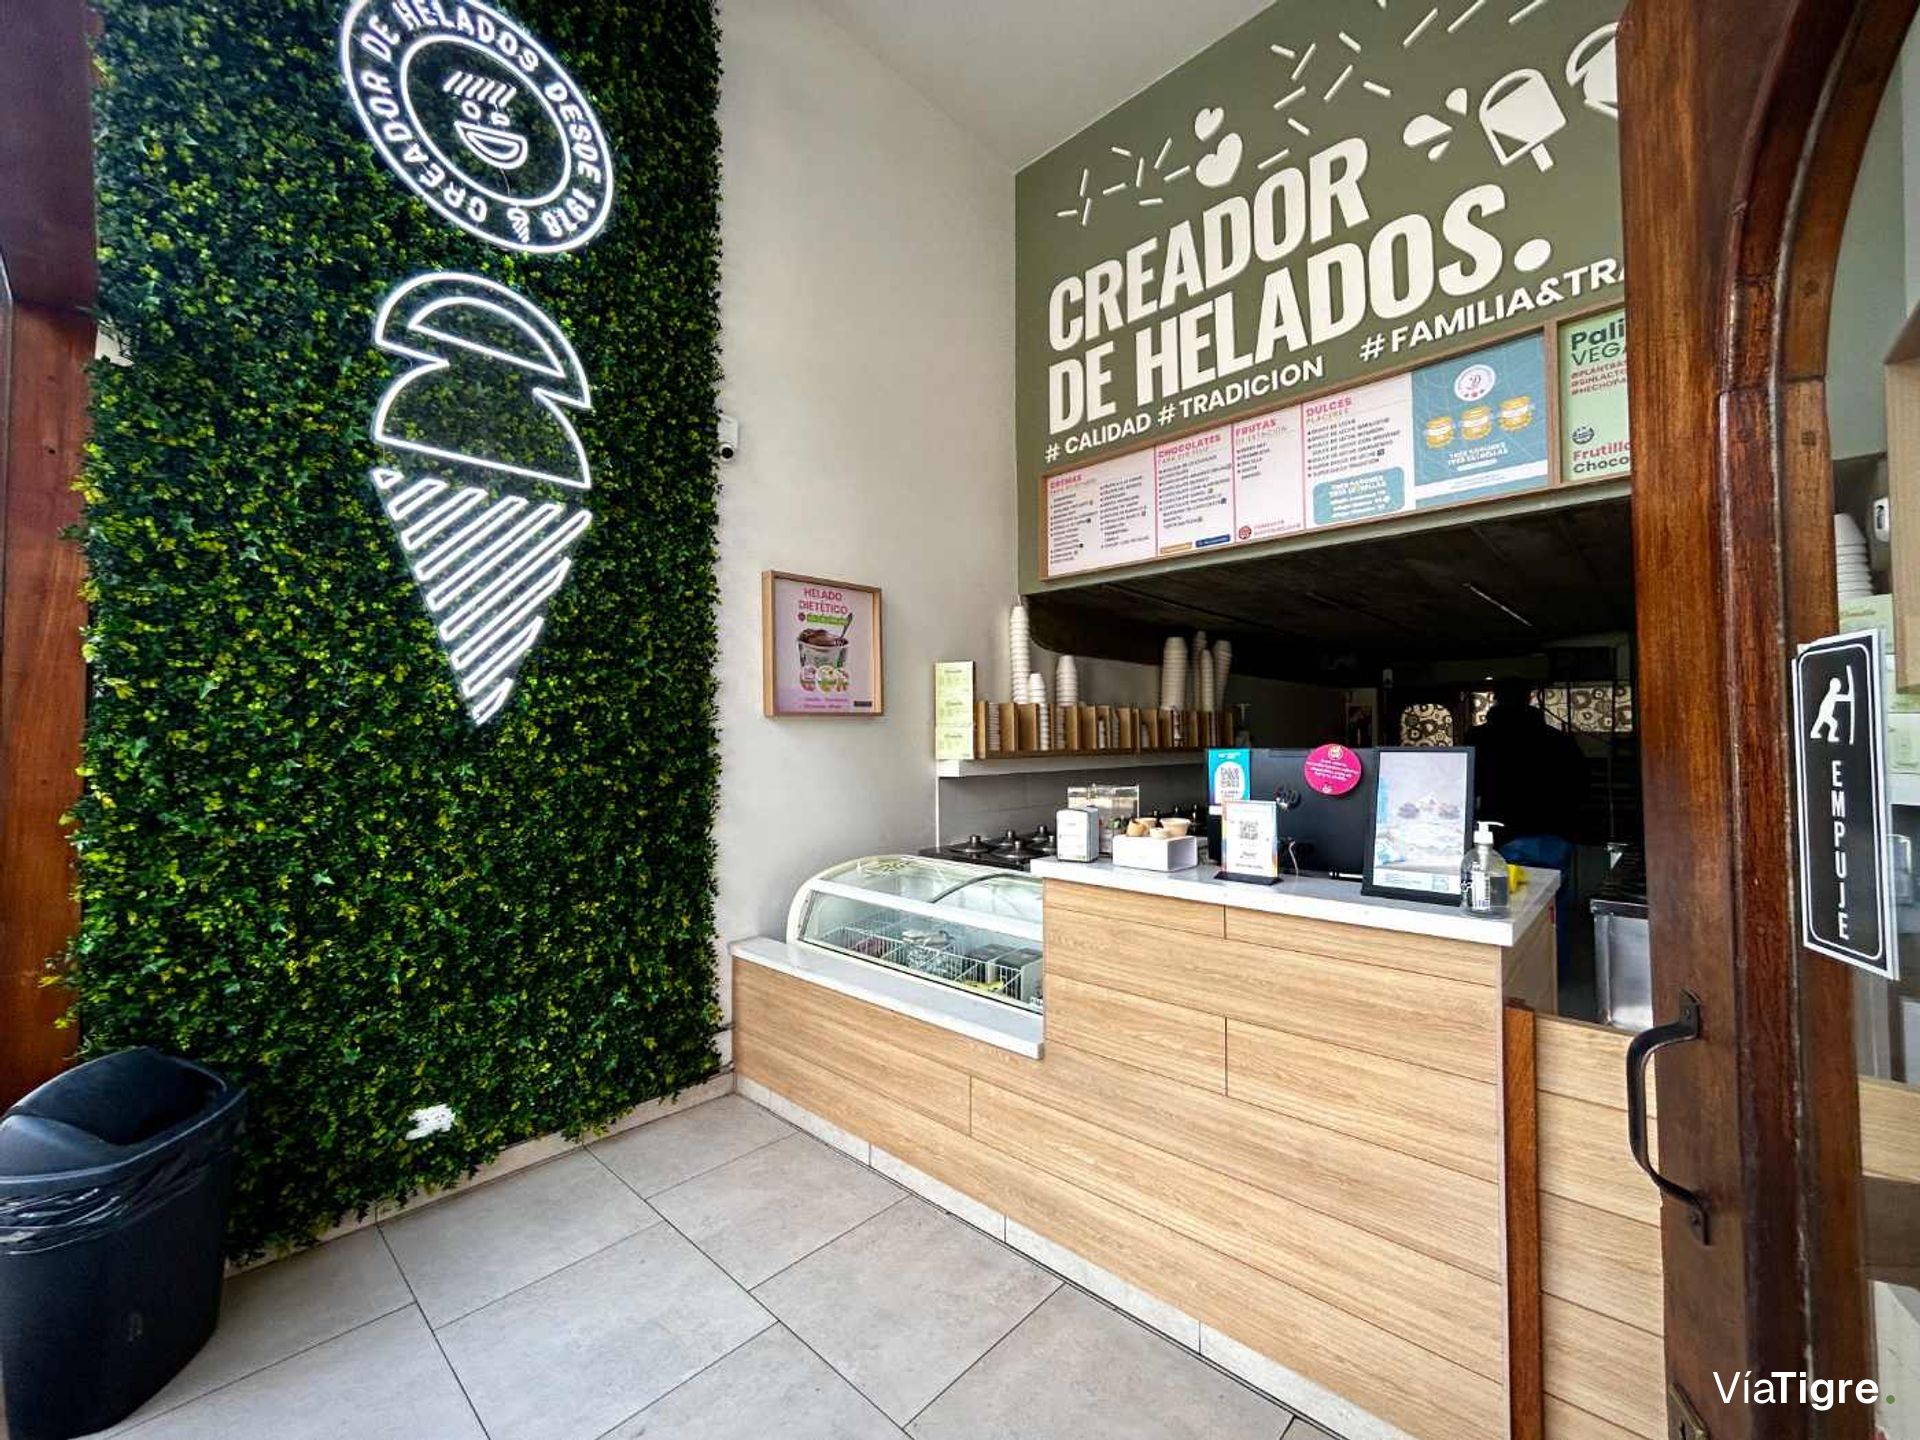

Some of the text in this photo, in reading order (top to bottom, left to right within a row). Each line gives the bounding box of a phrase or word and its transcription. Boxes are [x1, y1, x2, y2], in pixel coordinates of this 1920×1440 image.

[360, 0, 601, 238] CREADOR DE HELADOS DESDE 1978
[1049, 137, 1370, 351] CREADOR
[1049, 340, 1116, 435] DE
[1306, 397, 1352, 417] DULCES
[1236, 418, 1276, 437] FRUTAS
[1158, 434, 1221, 458] CHOCOLATES
[1573, 456, 1629, 473] Choco
[804, 588, 843, 602] HELADO
[1831, 760, 1850, 940] EMPUJE
